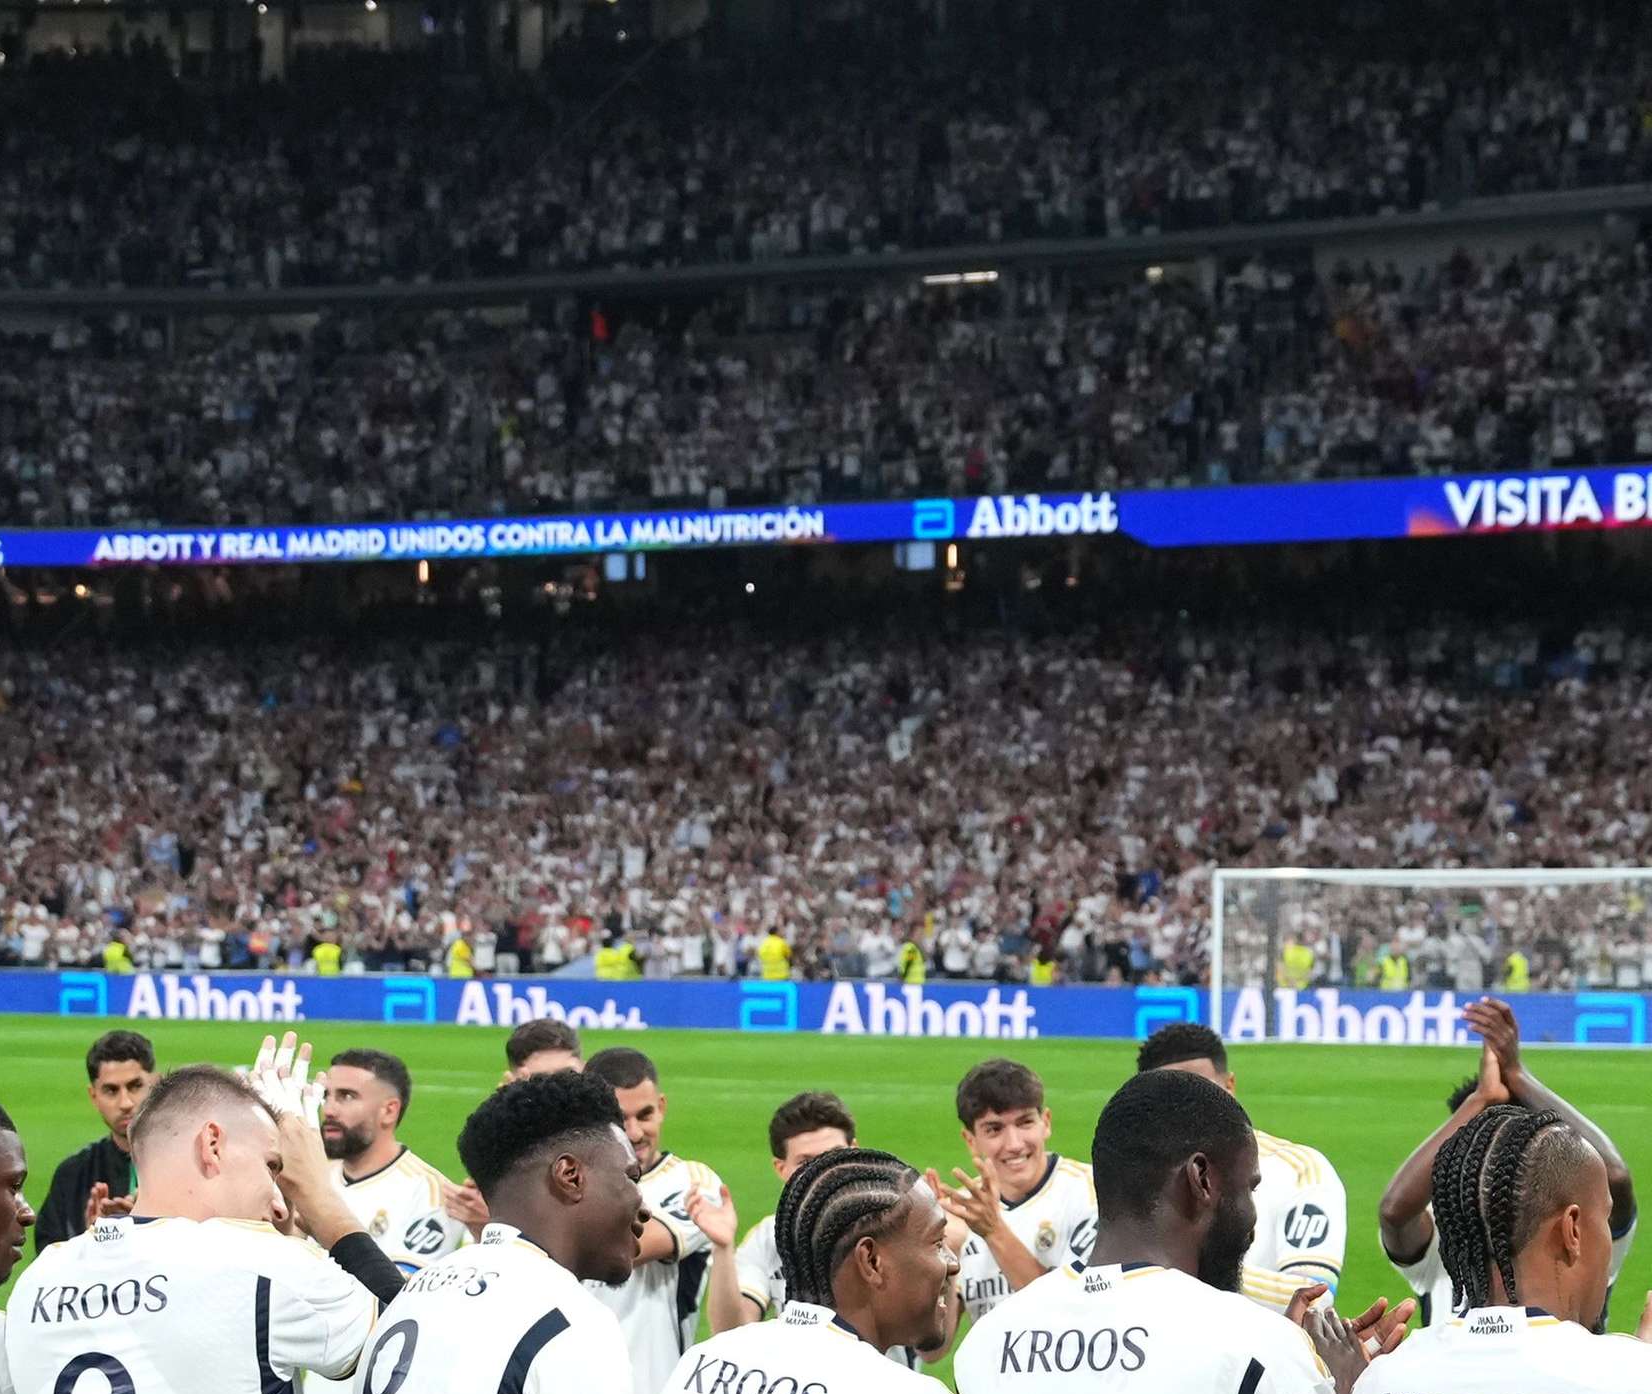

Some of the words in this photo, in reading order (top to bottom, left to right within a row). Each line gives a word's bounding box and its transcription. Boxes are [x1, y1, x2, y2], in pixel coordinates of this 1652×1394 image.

[966, 491, 1118, 538] Abbott
[1444, 475, 1605, 529] VISITA
[94, 533, 192, 562] ABBOTT
[196, 533, 217, 559] Y
[220, 531, 284, 560] REAL
[288, 528, 386, 559] MADRID
[389, 524, 486, 554] UNIDOS
[489, 519, 592, 550] CONTRA
[595, 516, 627, 545] LA
[631, 506, 825, 543] MALNUTRICIÓN
[127, 973, 305, 1021] Abbott
[821, 982, 1039, 1040] Abbott
[1228, 987, 1468, 1045] Abbott
[404, 1218, 445, 1255] hp
[1284, 1203, 1329, 1249] hp
[30, 1273, 170, 1325] KROOS
[999, 1325, 1150, 1374] KROOS
[1469, 1324, 1514, 1335] MADRID!
